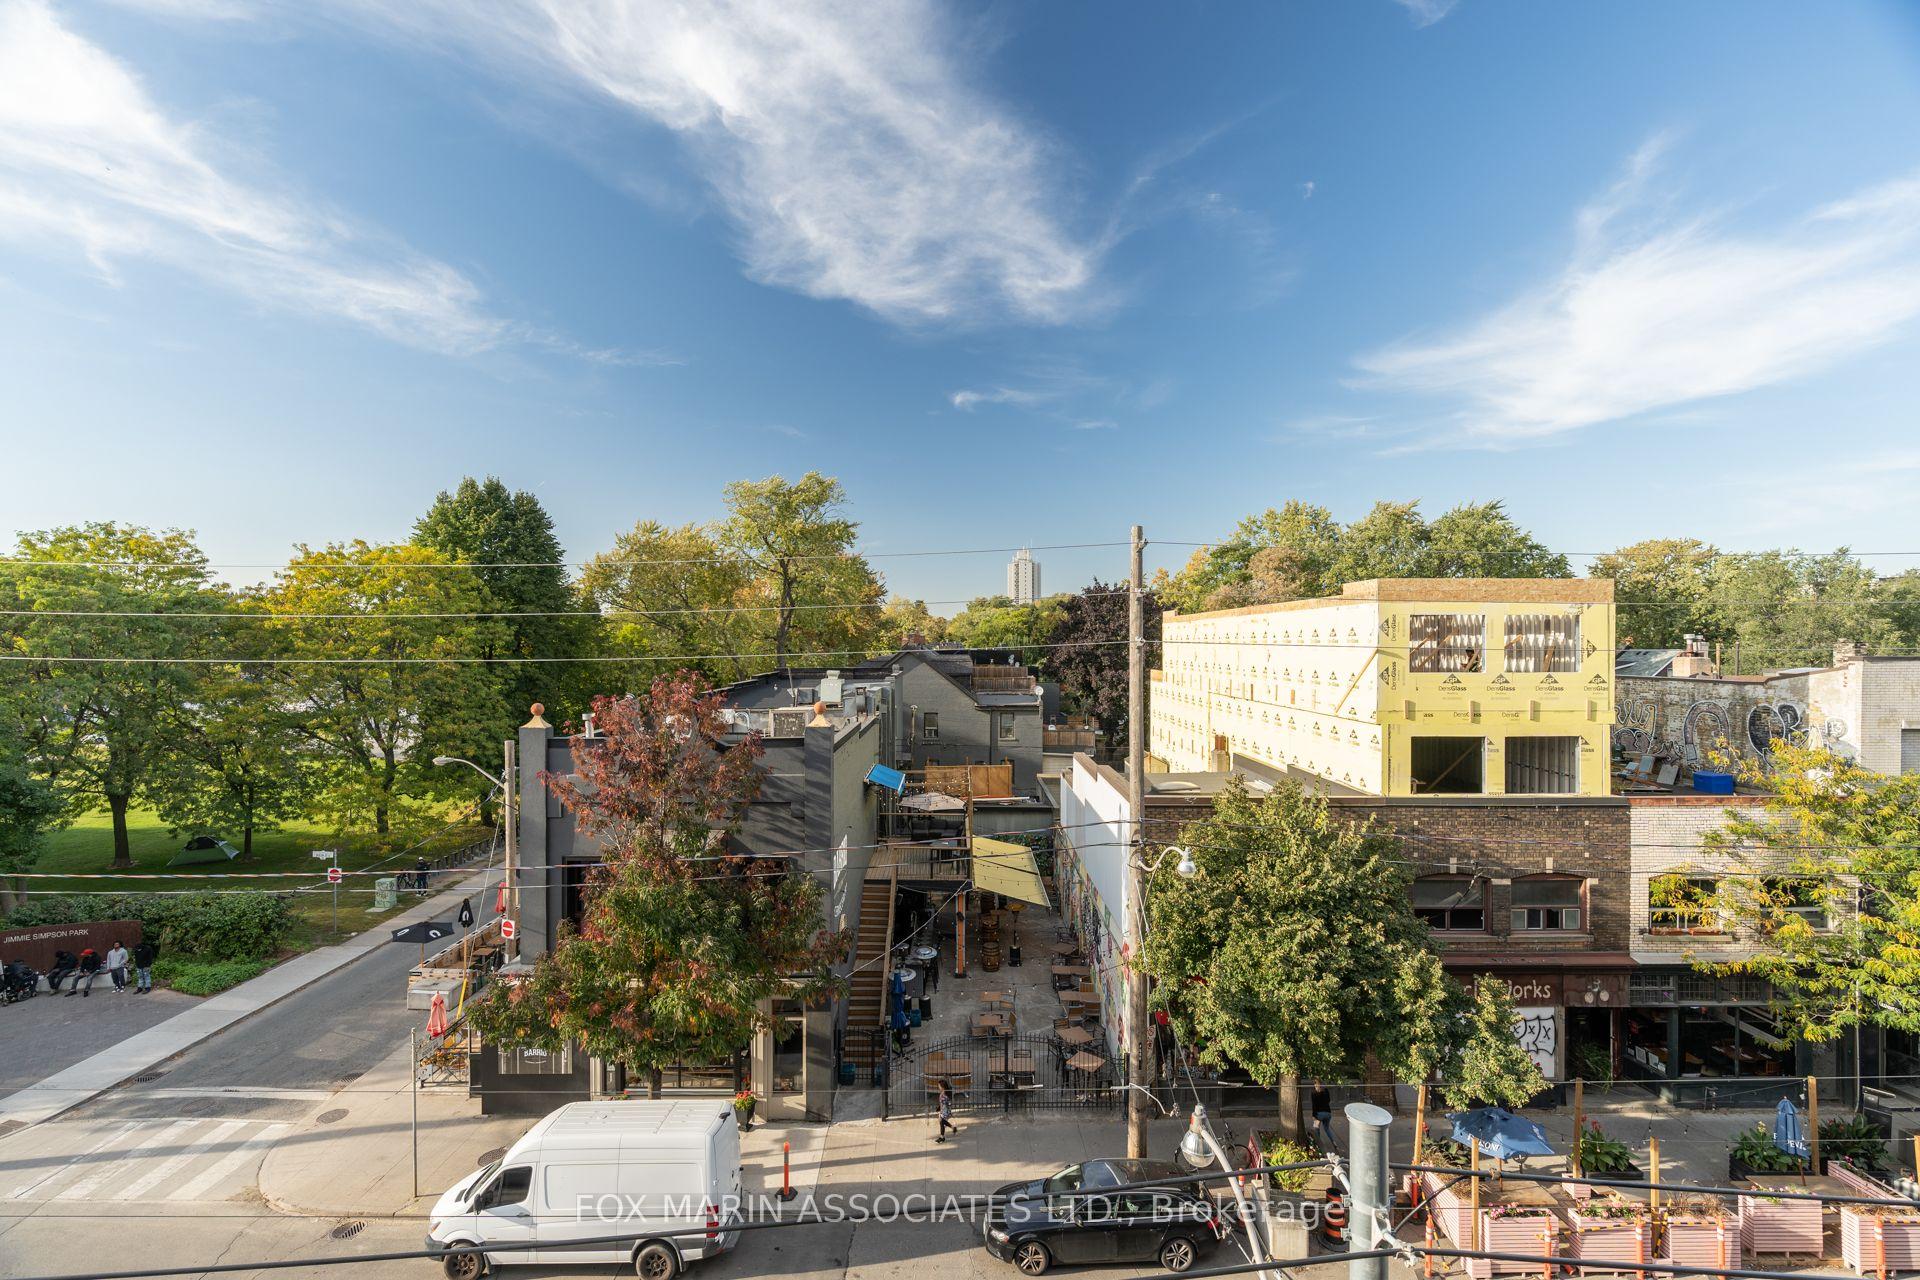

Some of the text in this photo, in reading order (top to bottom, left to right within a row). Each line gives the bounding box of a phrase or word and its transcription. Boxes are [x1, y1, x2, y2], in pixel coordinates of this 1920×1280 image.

[4, 929, 89, 943] JIMMIE SIMPSON PARK
